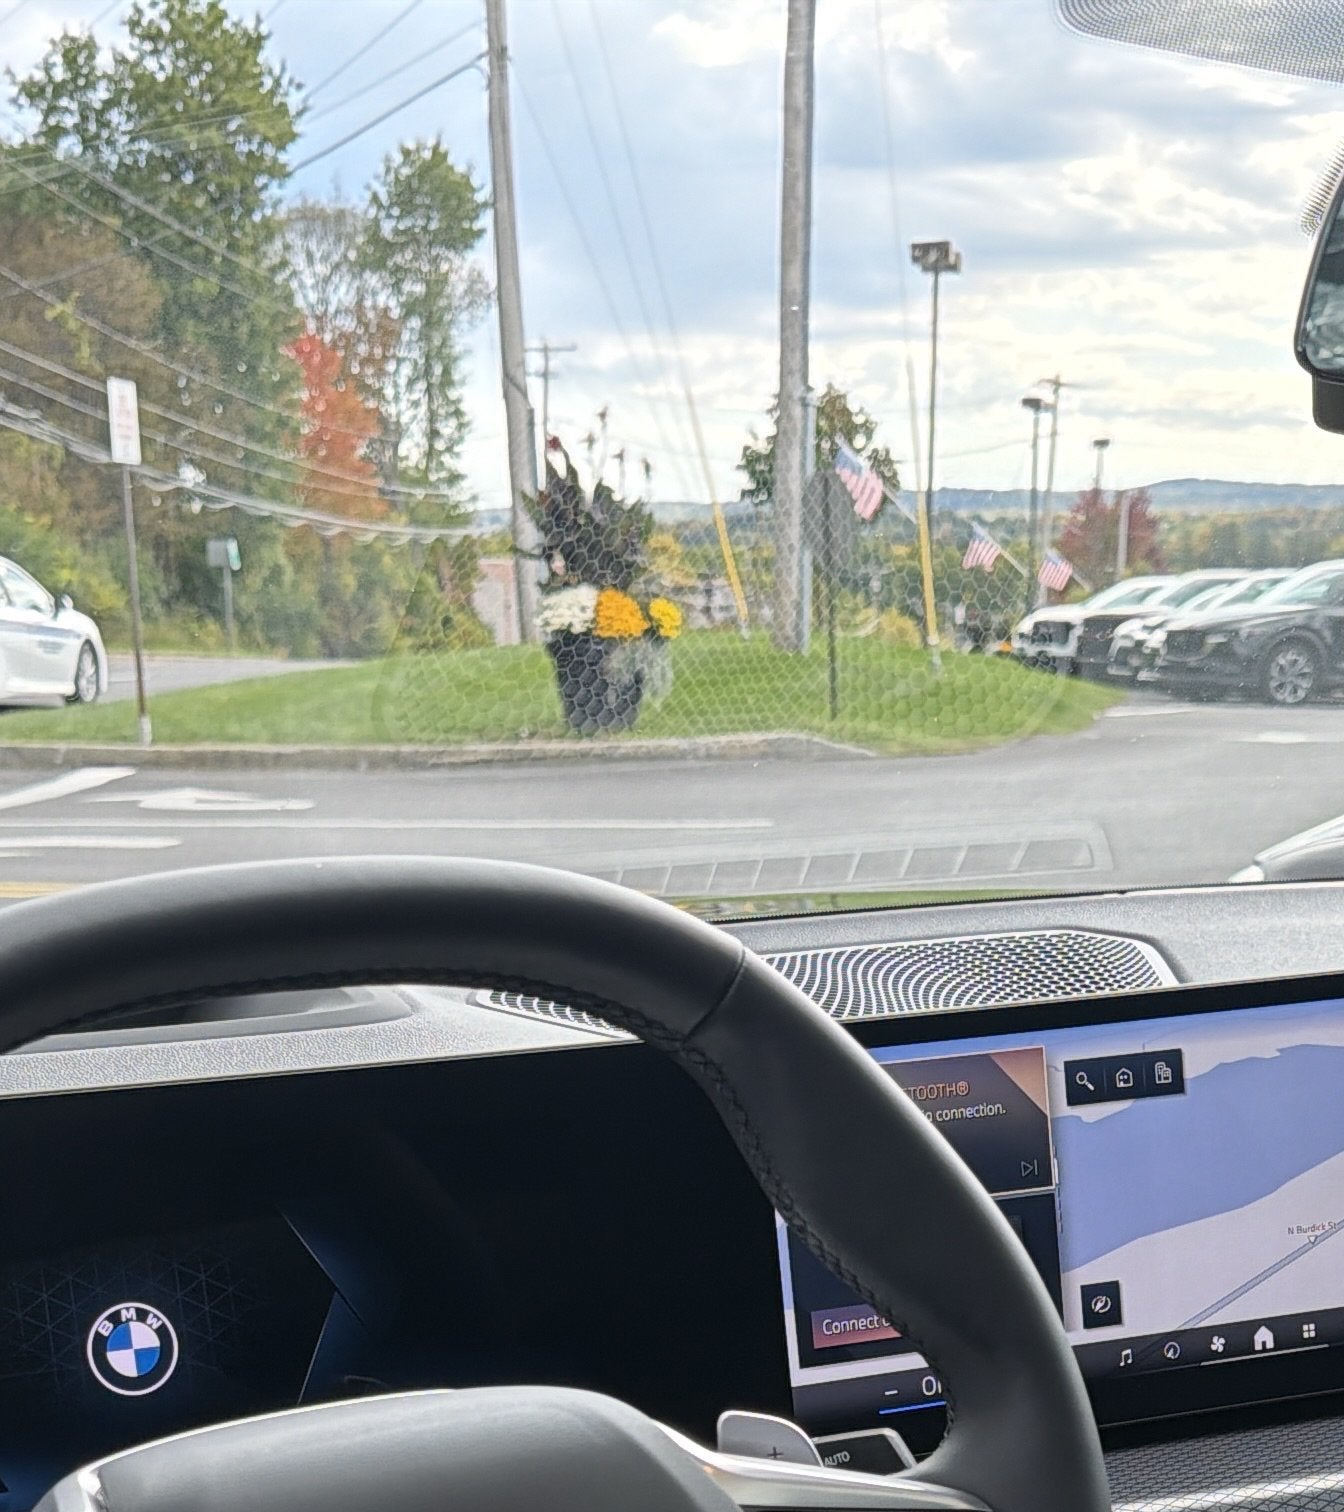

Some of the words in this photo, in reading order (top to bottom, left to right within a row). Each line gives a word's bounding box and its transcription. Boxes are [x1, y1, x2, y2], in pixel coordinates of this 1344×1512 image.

[908, 1080, 969, 1100] TOOTH®
[936, 1102, 1006, 1122] connection.
[1296, 1223, 1326, 1235] Burdick
[1328, 1221, 1338, 1232] St
[97, 1307, 163, 1337] BMW
[822, 1314, 879, 1335] Connect
[824, 1450, 850, 1467] AUTO
